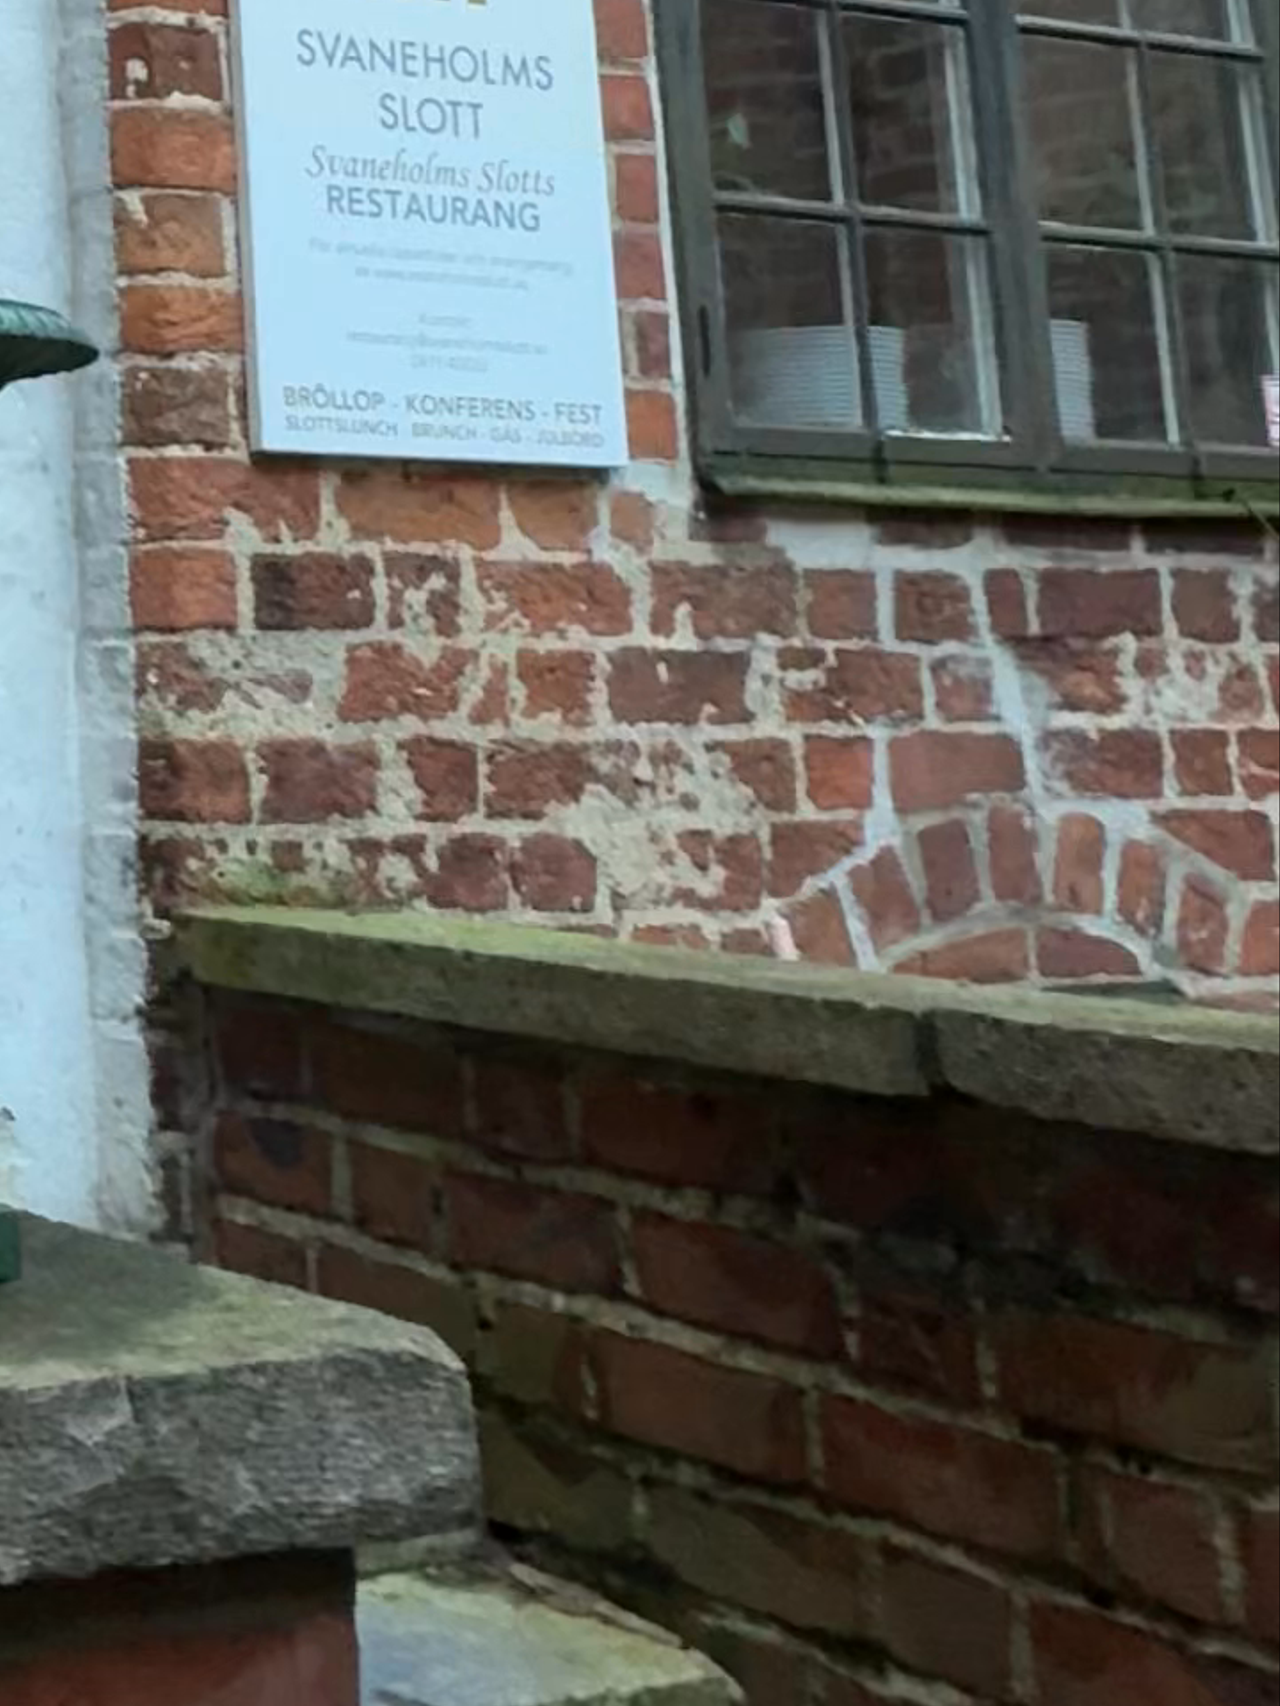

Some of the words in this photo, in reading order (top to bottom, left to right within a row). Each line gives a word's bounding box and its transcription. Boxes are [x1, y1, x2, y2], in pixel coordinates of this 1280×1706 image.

[297, 28, 554, 91] SVANEHOLMS
[379, 92, 483, 140] SLOTT
[304, 144, 470, 189] Svaneholms
[476, 158, 556, 197] Slotts
[326, 183, 541, 232] RESTAURANG
[404, 394, 536, 422] KONFERENS
[554, 401, 603, 425] FEST
